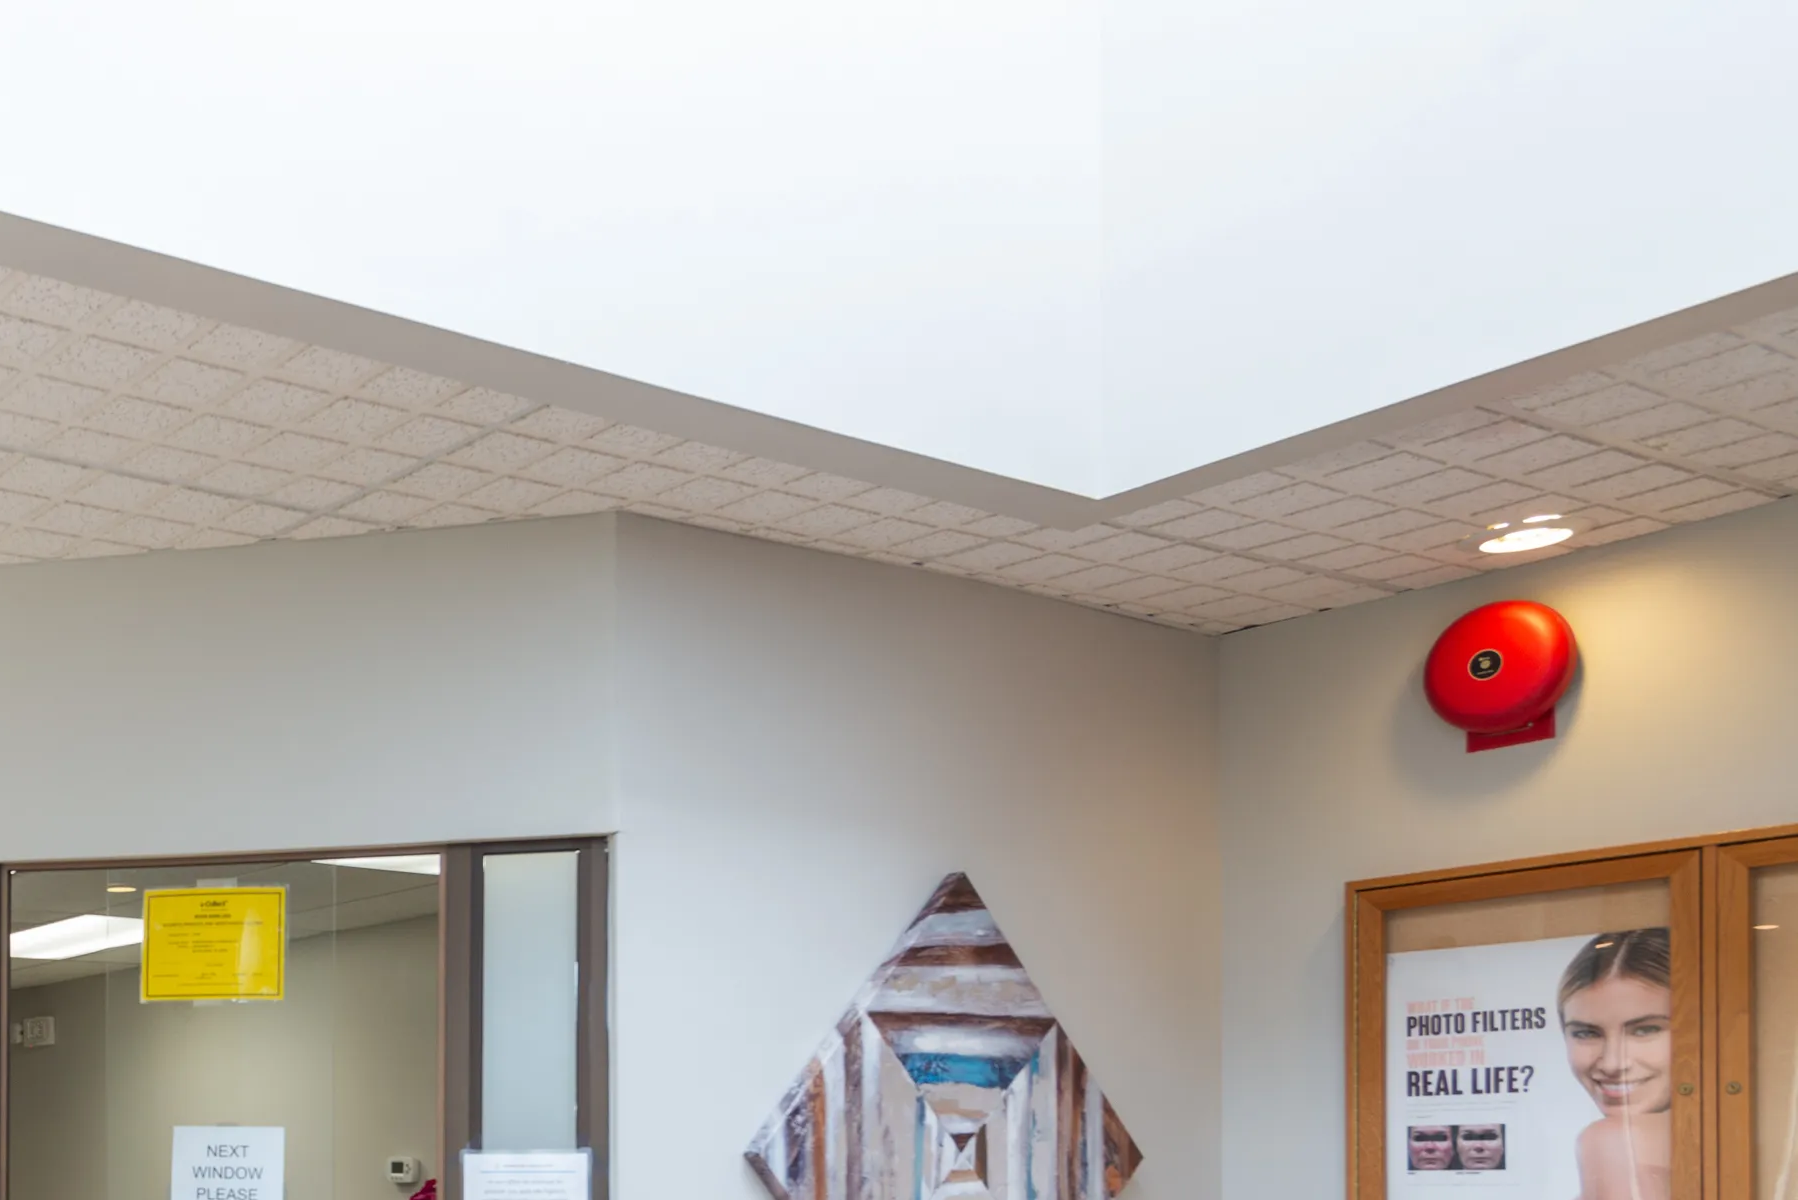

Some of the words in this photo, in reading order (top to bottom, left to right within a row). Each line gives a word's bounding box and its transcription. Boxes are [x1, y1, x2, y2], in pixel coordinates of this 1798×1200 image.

[1406, 1012, 1465, 1037] PHOTO
[1471, 1007, 1546, 1033] FILTERS
[1406, 1068, 1463, 1097] REAL
[1471, 1065, 1534, 1094] LIFE?
[206, 1144, 250, 1158] NEXT
[192, 1166, 264, 1180] WINDOW
